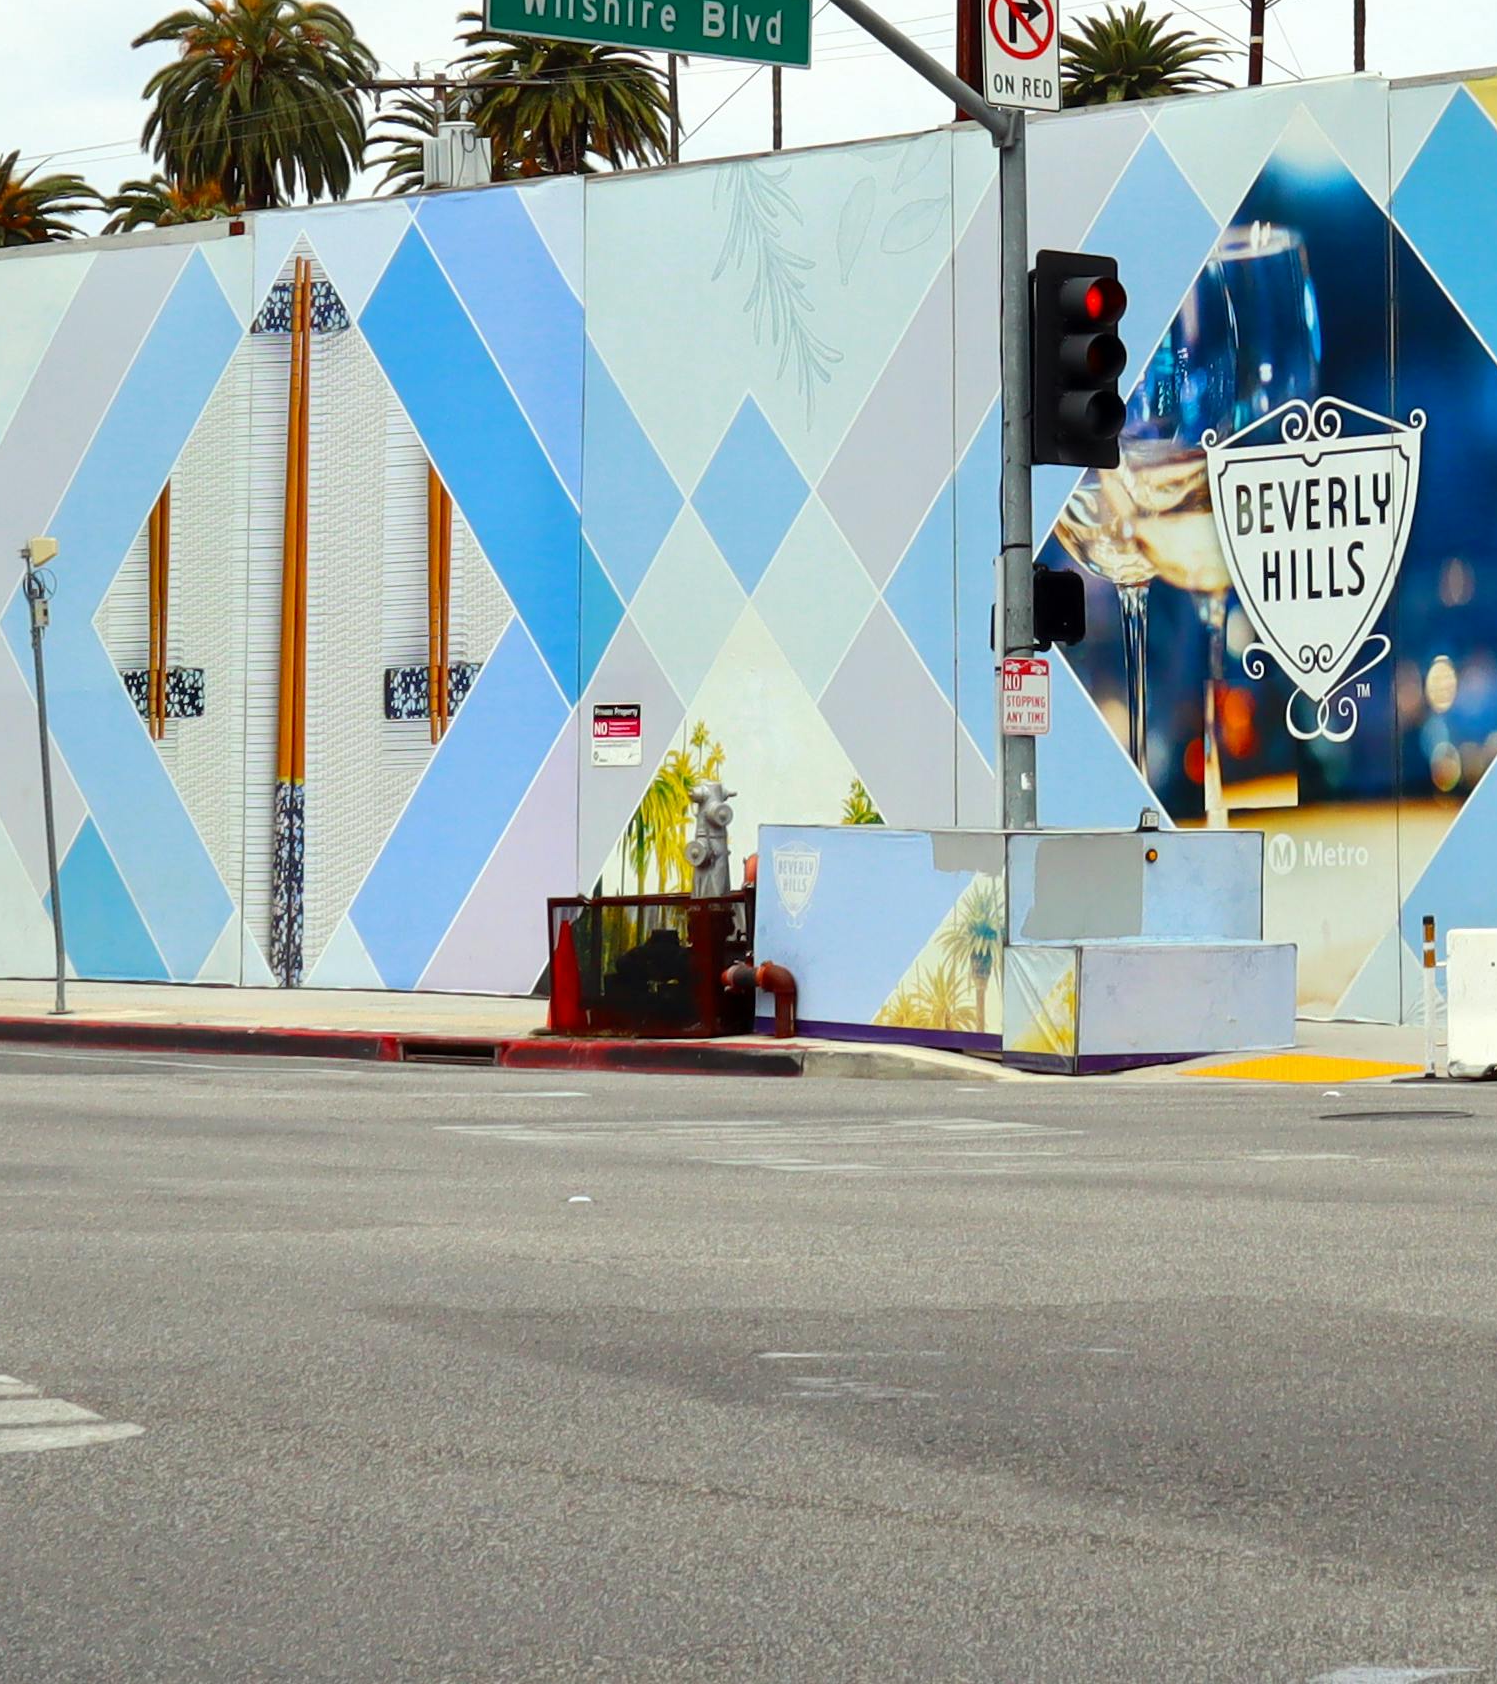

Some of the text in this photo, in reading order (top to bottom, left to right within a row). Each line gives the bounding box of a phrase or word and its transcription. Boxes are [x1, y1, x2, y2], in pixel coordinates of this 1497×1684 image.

[702, 0, 783, 45] Blvd
[993, 73, 1053, 99] ON RED
[1235, 471, 1392, 537] BEVERLY
[1261, 540, 1366, 603] HILLS
[1004, 674, 1021, 691] NO
[1006, 695, 1046, 708] STOPPING
[1006, 711, 1046, 724] ANY TIME
[594, 721, 608, 736] NO
[1303, 840, 1369, 867] Metro
[777, 859, 815, 876] BEVERLY
[782, 877, 808, 893] HILLS
